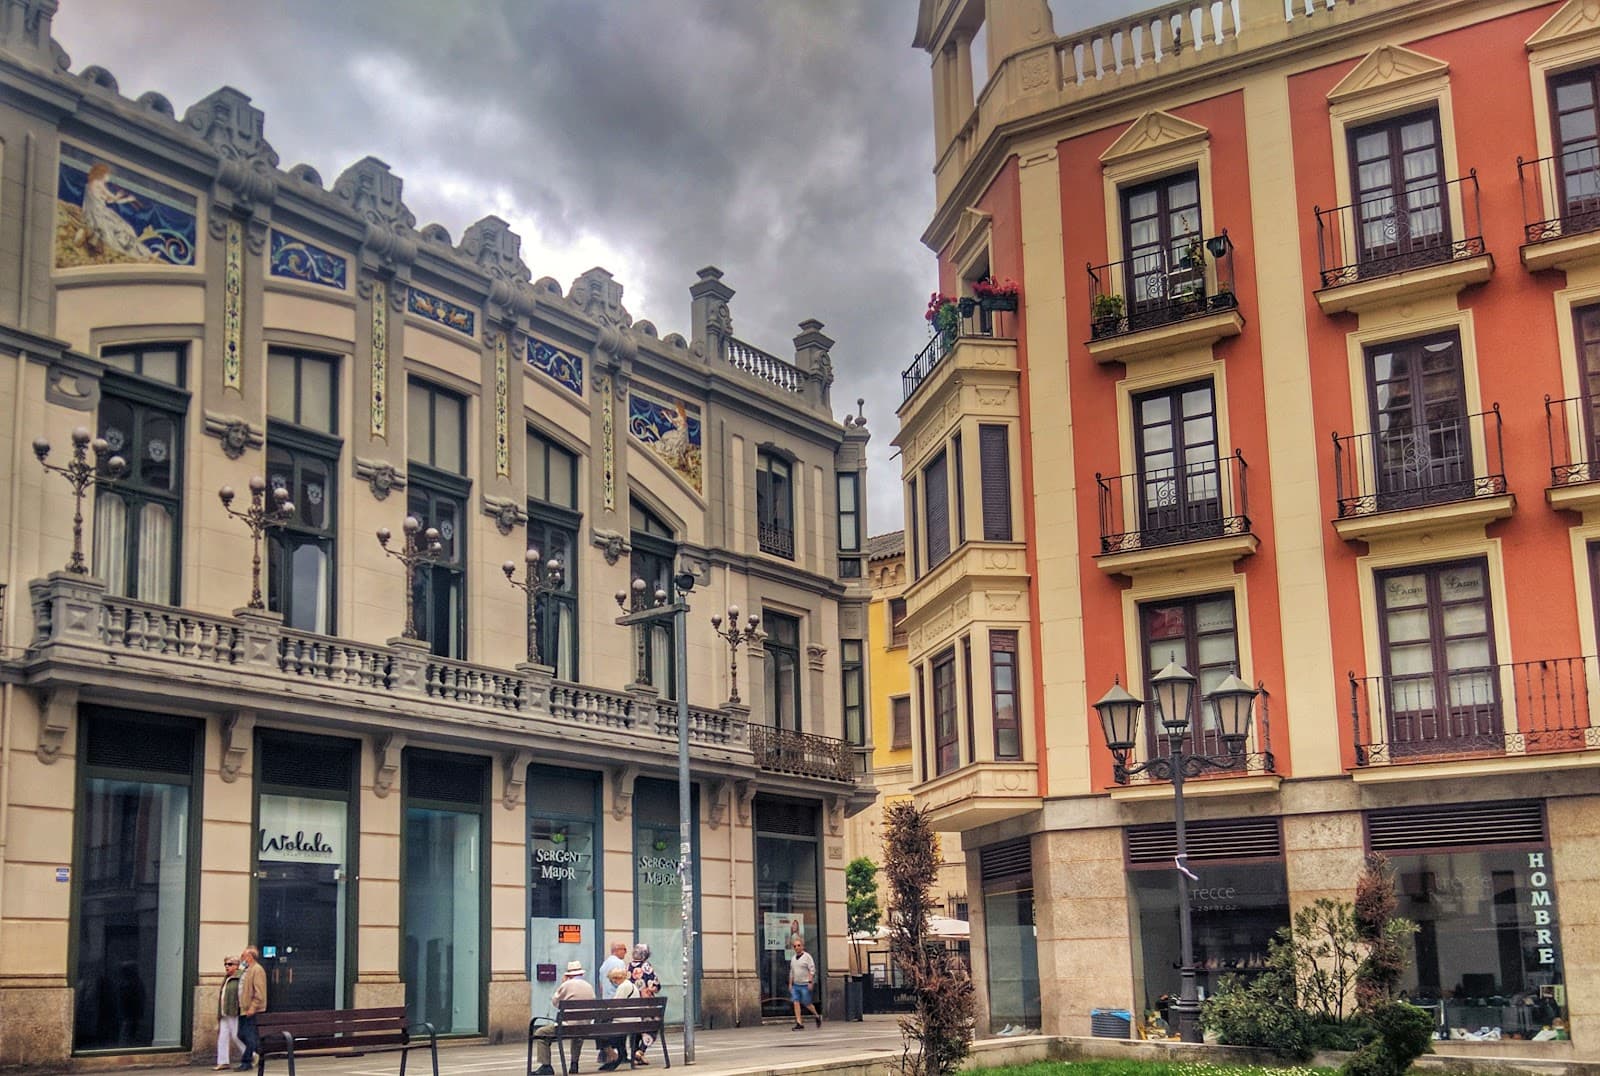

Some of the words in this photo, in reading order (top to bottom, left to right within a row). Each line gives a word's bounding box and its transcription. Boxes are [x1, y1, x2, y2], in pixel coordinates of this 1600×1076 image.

[259, 828, 332, 853] Wolala
[1189, 887, 1235, 901] recce
[1527, 852, 1555, 964] HOMBRE
